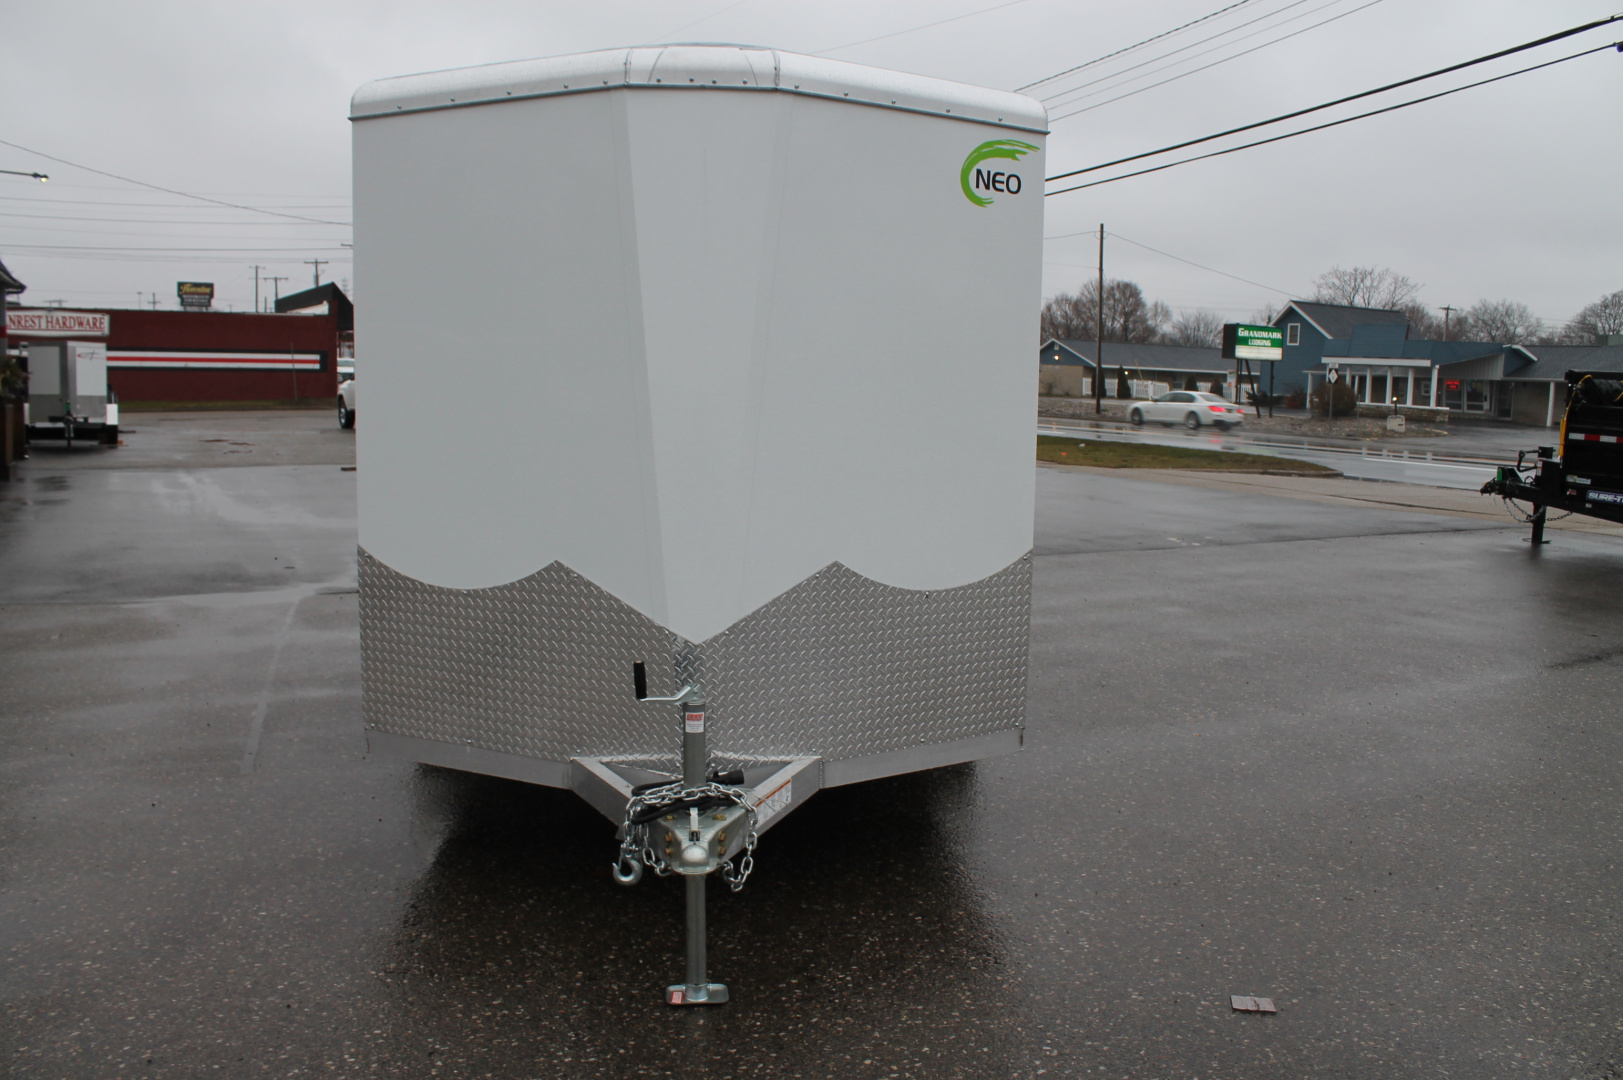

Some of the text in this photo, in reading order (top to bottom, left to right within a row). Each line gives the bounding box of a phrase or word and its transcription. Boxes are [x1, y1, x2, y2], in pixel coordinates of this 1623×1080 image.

[975, 168, 1022, 195] NEO
[7, 314, 105, 330] NREST HARDWARE
[1238, 327, 1282, 339] GRANDMARK
[1588, 492, 1623, 503] SURE-T
